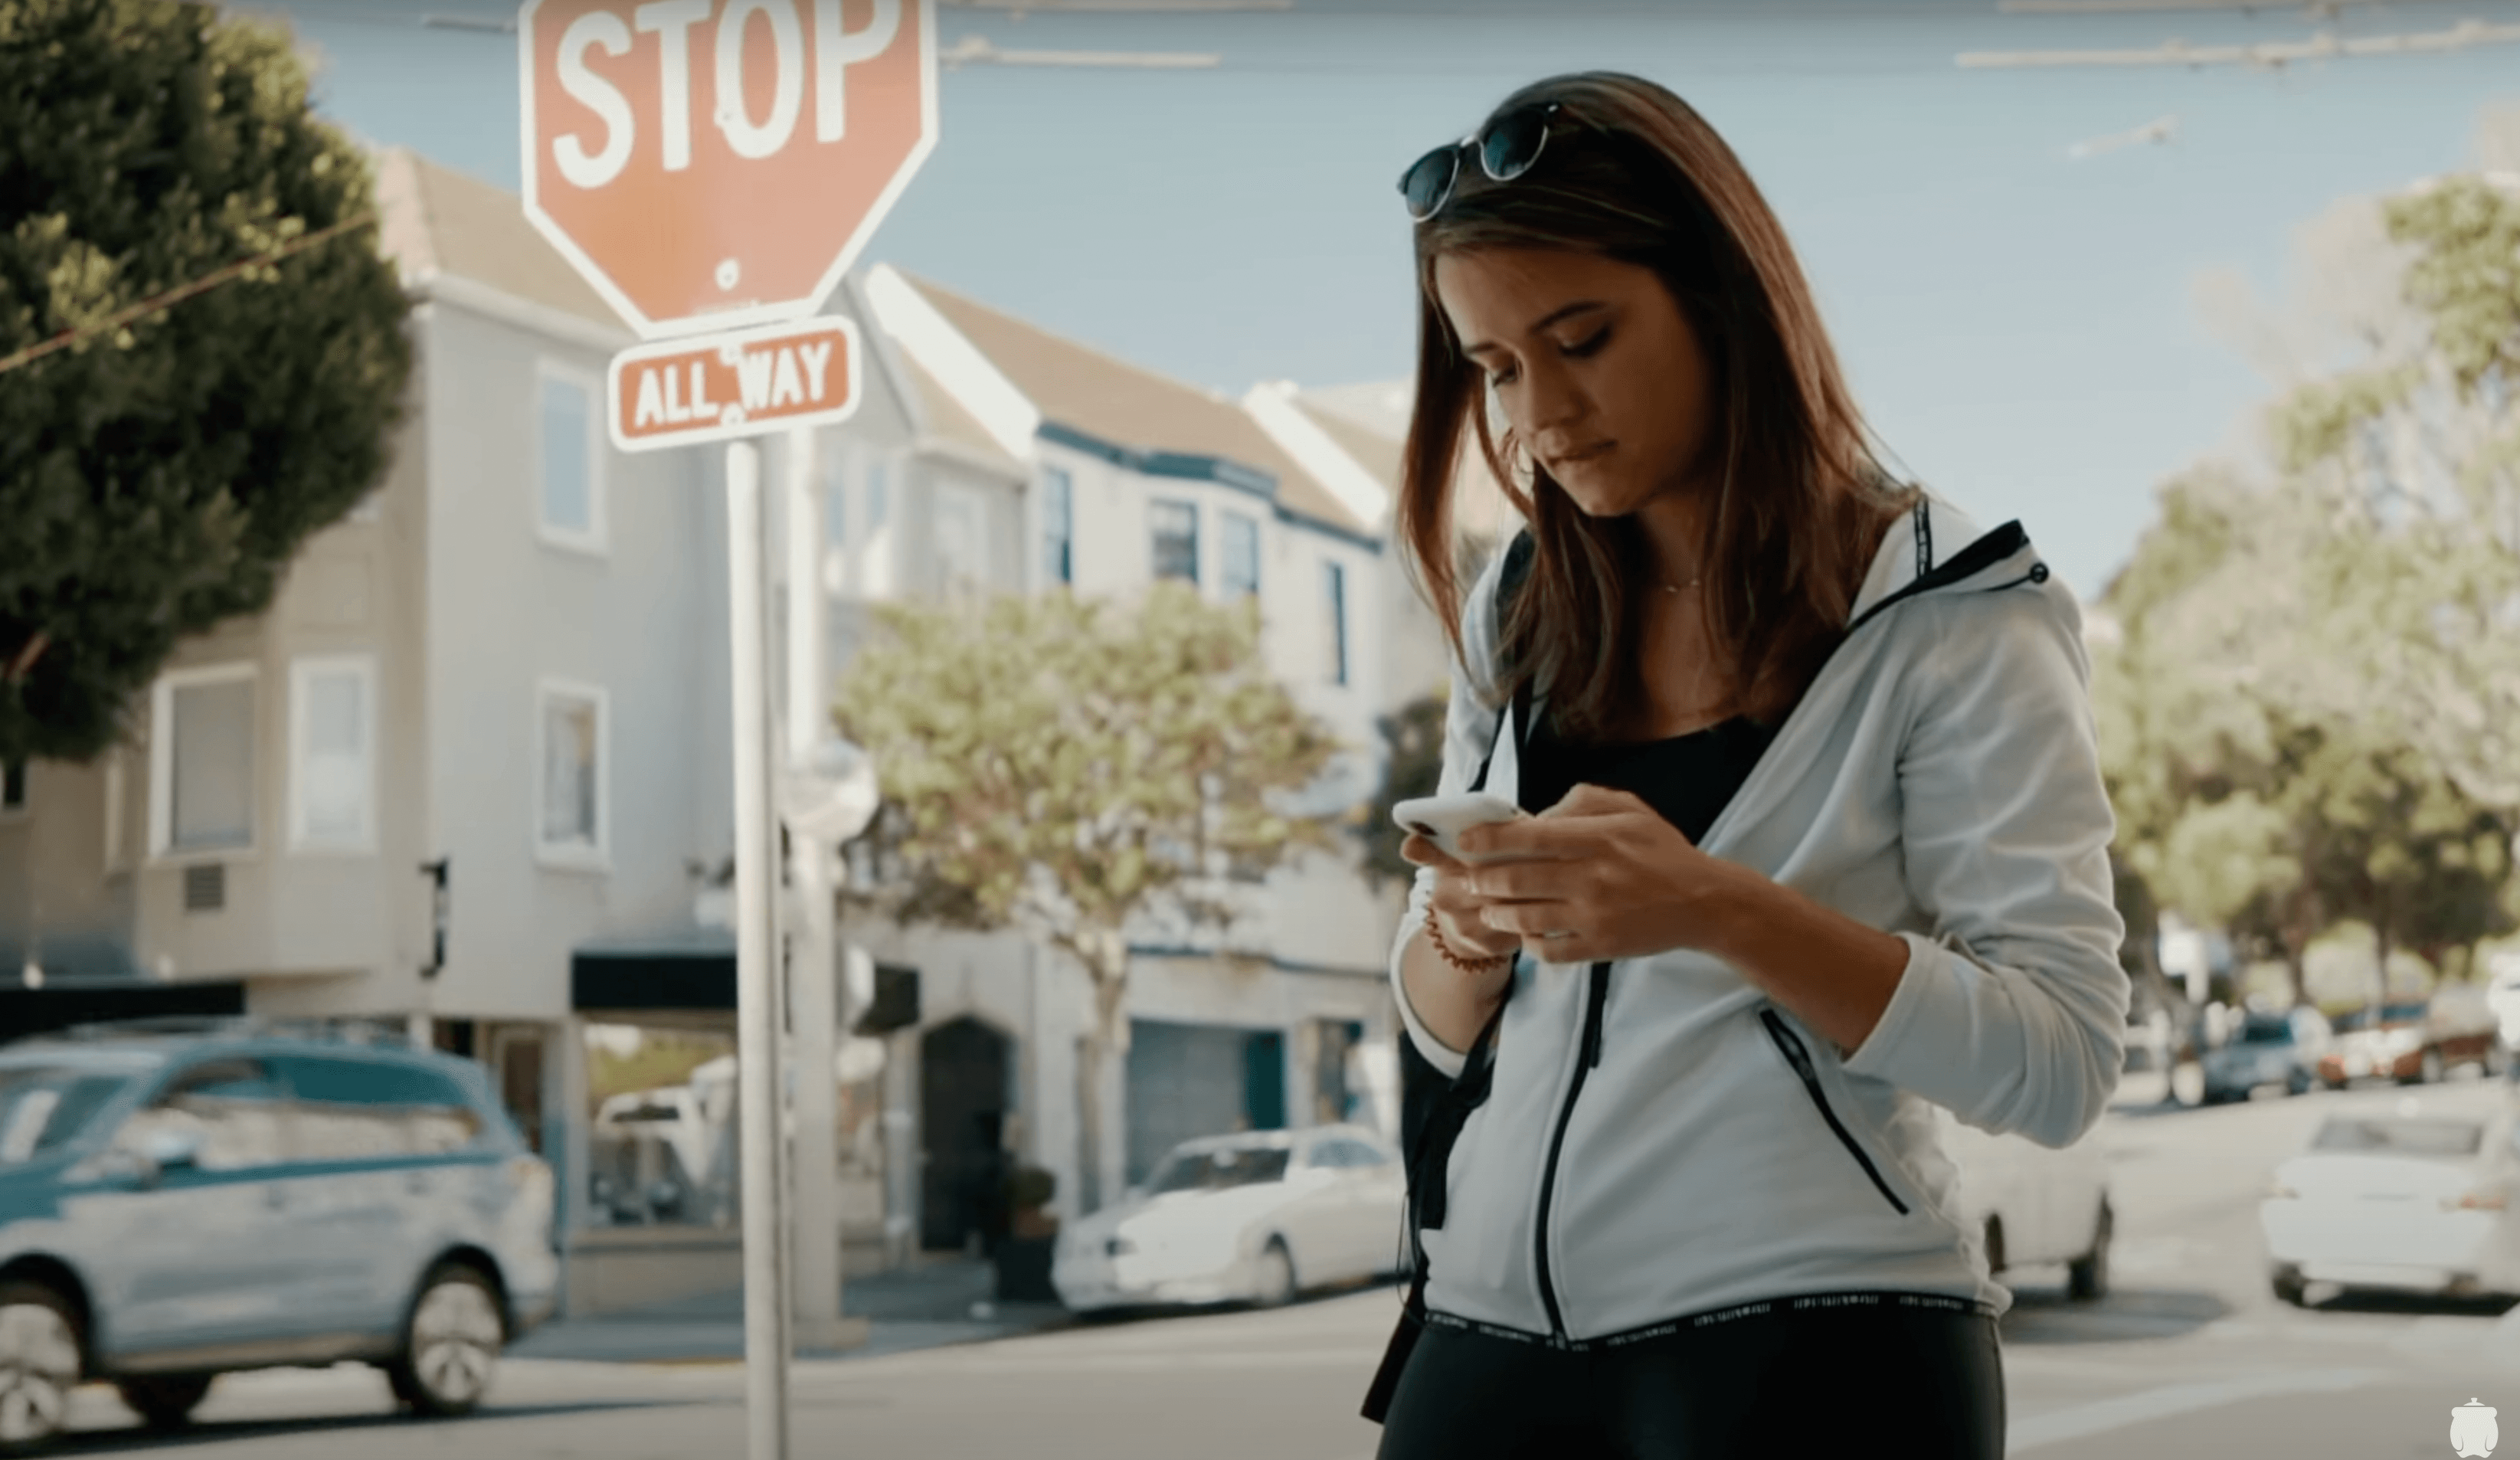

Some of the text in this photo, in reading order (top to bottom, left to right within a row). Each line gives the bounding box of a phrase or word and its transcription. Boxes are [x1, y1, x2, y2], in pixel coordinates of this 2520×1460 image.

[552, 0, 902, 189] STOP
[634, 341, 832, 428] ALL WAY
